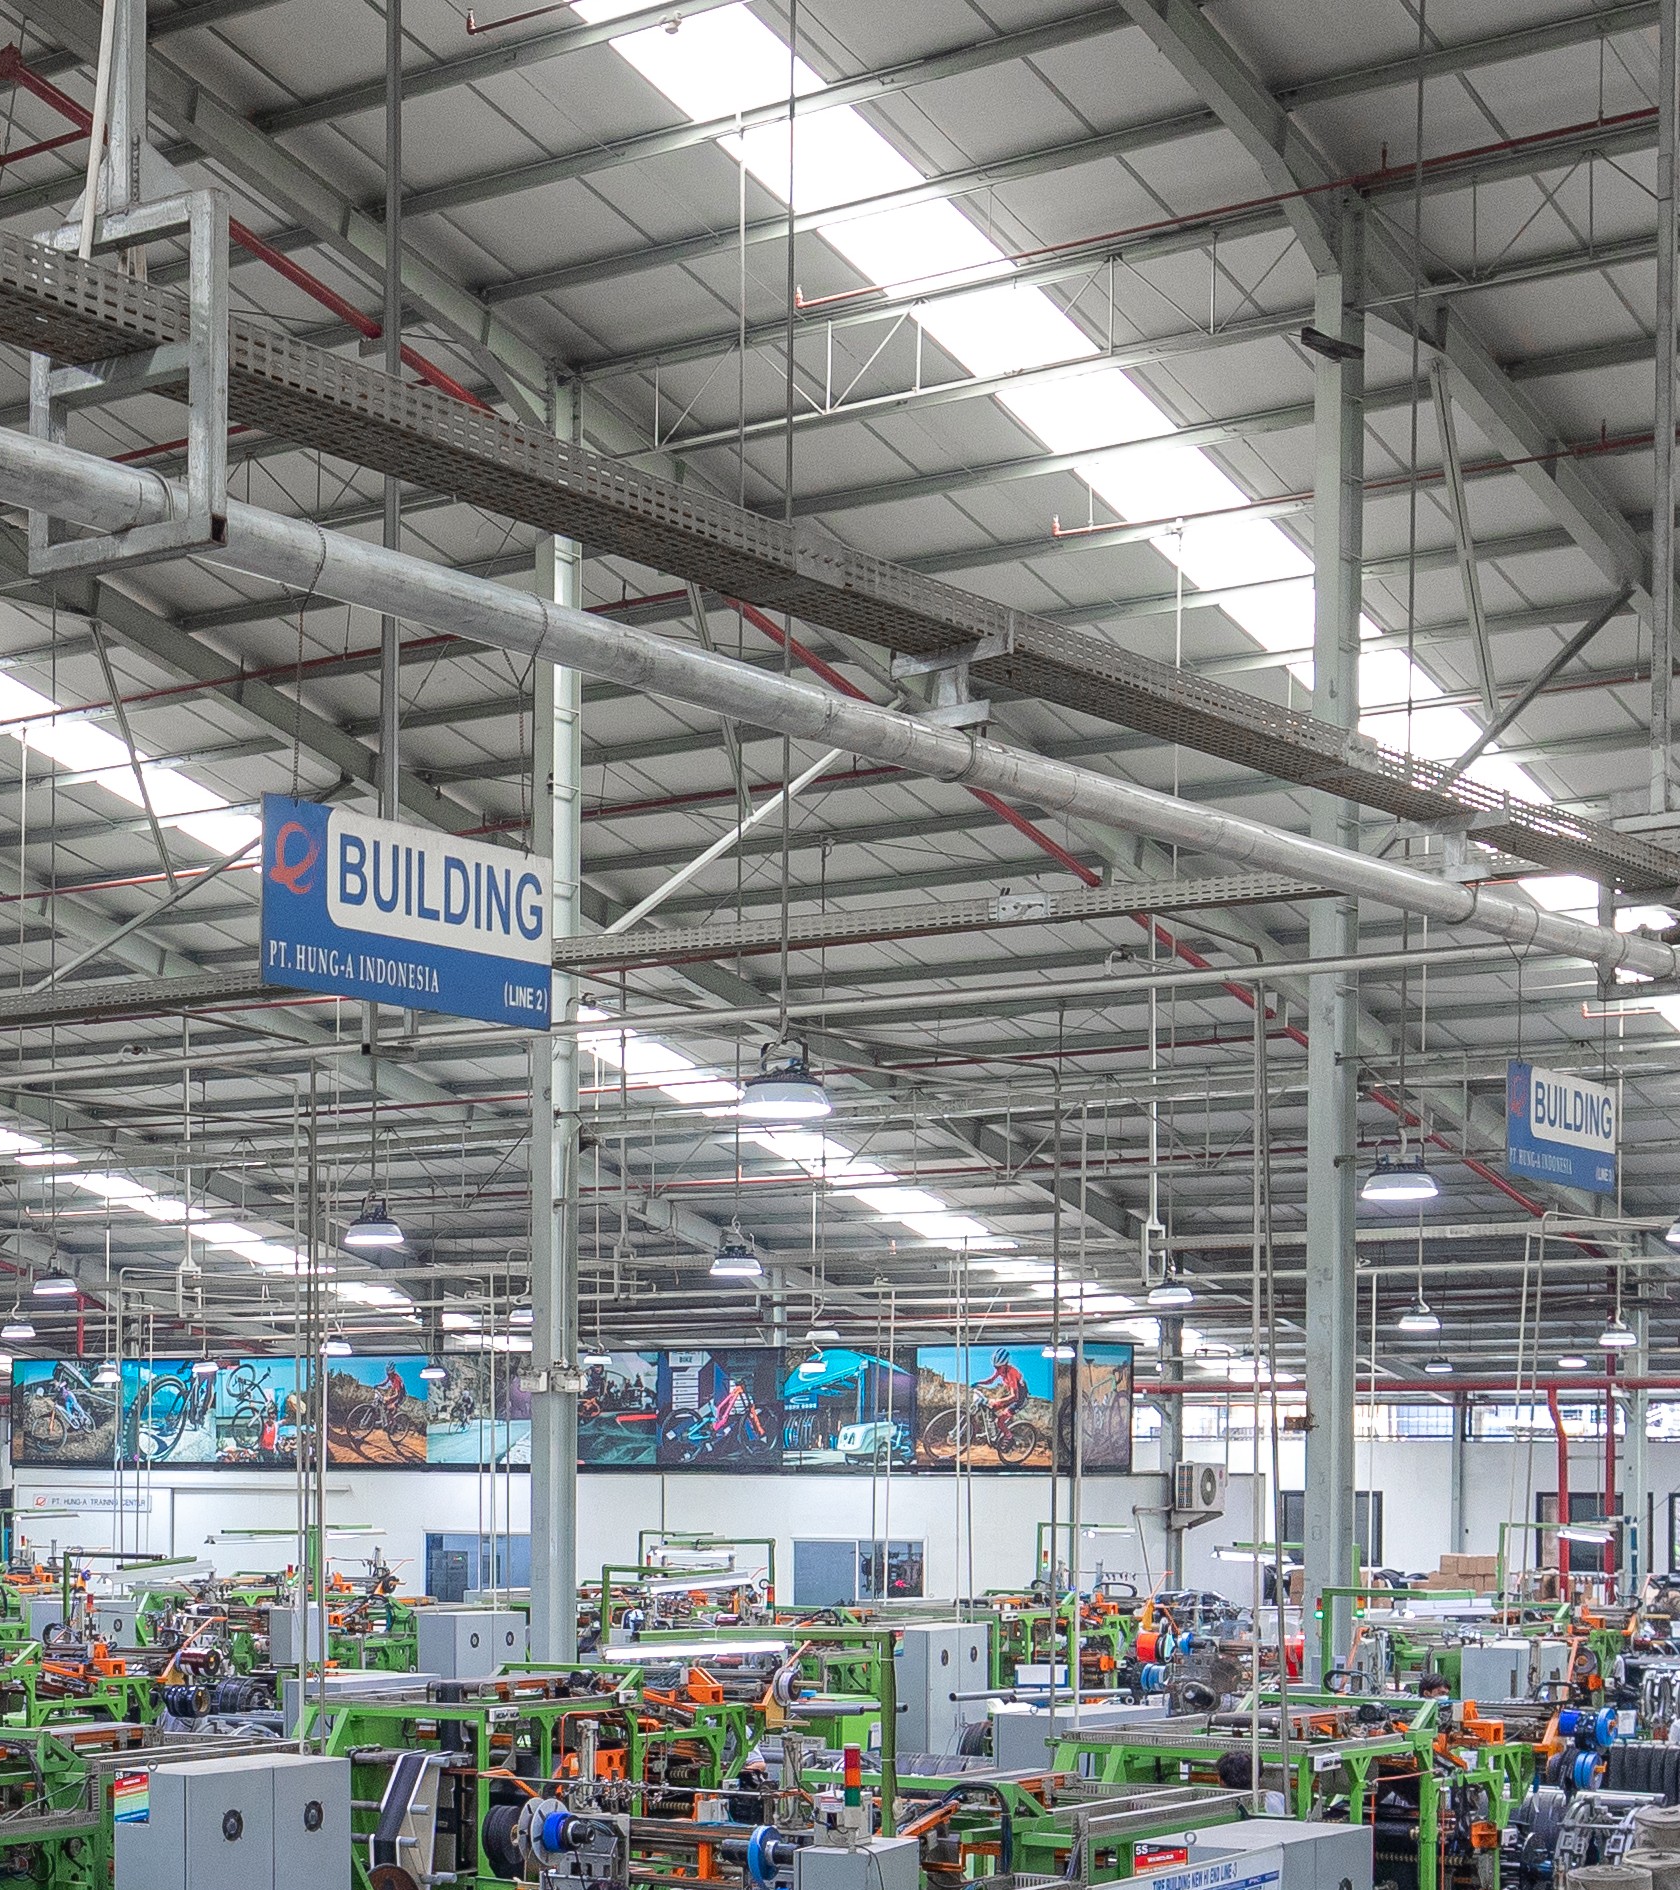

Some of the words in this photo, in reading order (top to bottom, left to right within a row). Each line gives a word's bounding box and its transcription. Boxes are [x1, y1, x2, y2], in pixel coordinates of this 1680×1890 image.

[339, 832, 543, 941] BUILDING
[269, 939, 291, 968] PT.
[296, 944, 354, 979] HUNG-A
[359, 954, 440, 993] INDONESIA
[503, 981, 533, 1010] (LINE
[534, 989, 547, 1013] 2)
[1535, 1081, 1612, 1140] BUILDING
[1135, 1845, 1148, 1855] 5S
[1192, 1870, 1203, 1885] NEW
[1210, 1866, 1220, 1883] END
[1221, 1863, 1231, 1881] LINE
